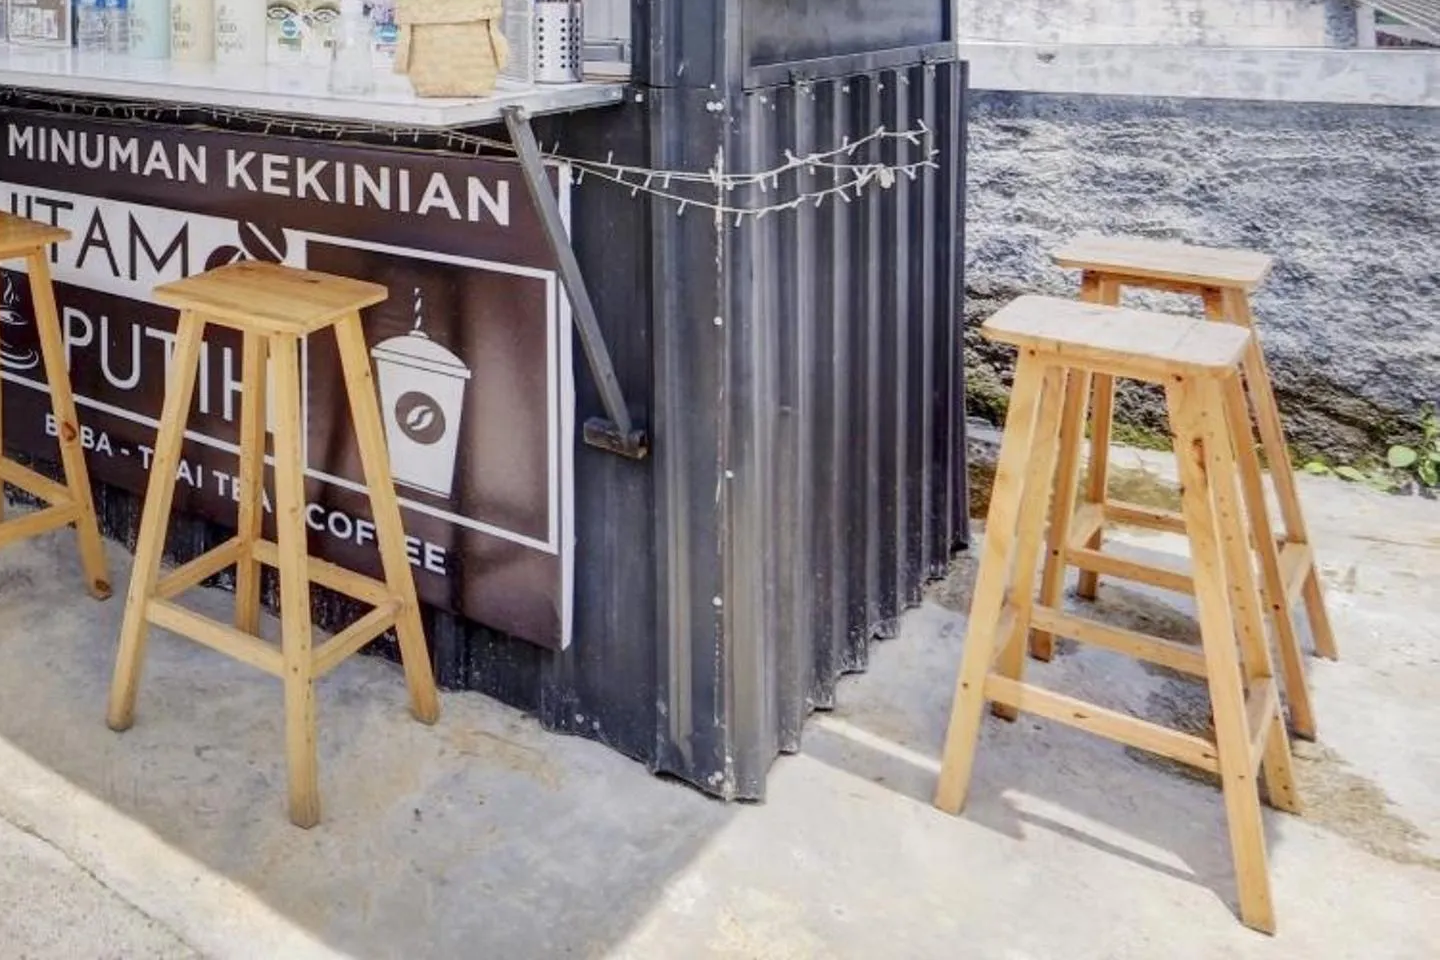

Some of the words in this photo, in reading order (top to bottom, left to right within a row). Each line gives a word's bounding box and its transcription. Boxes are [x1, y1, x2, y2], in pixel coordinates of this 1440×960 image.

[8, 123, 207, 185] MINUMAN
[226, 149, 510, 227] KEKINIAN
[45, 413, 112, 457] BBA
[138, 445, 202, 489] TAI
[305, 503, 446, 576] COFEE
